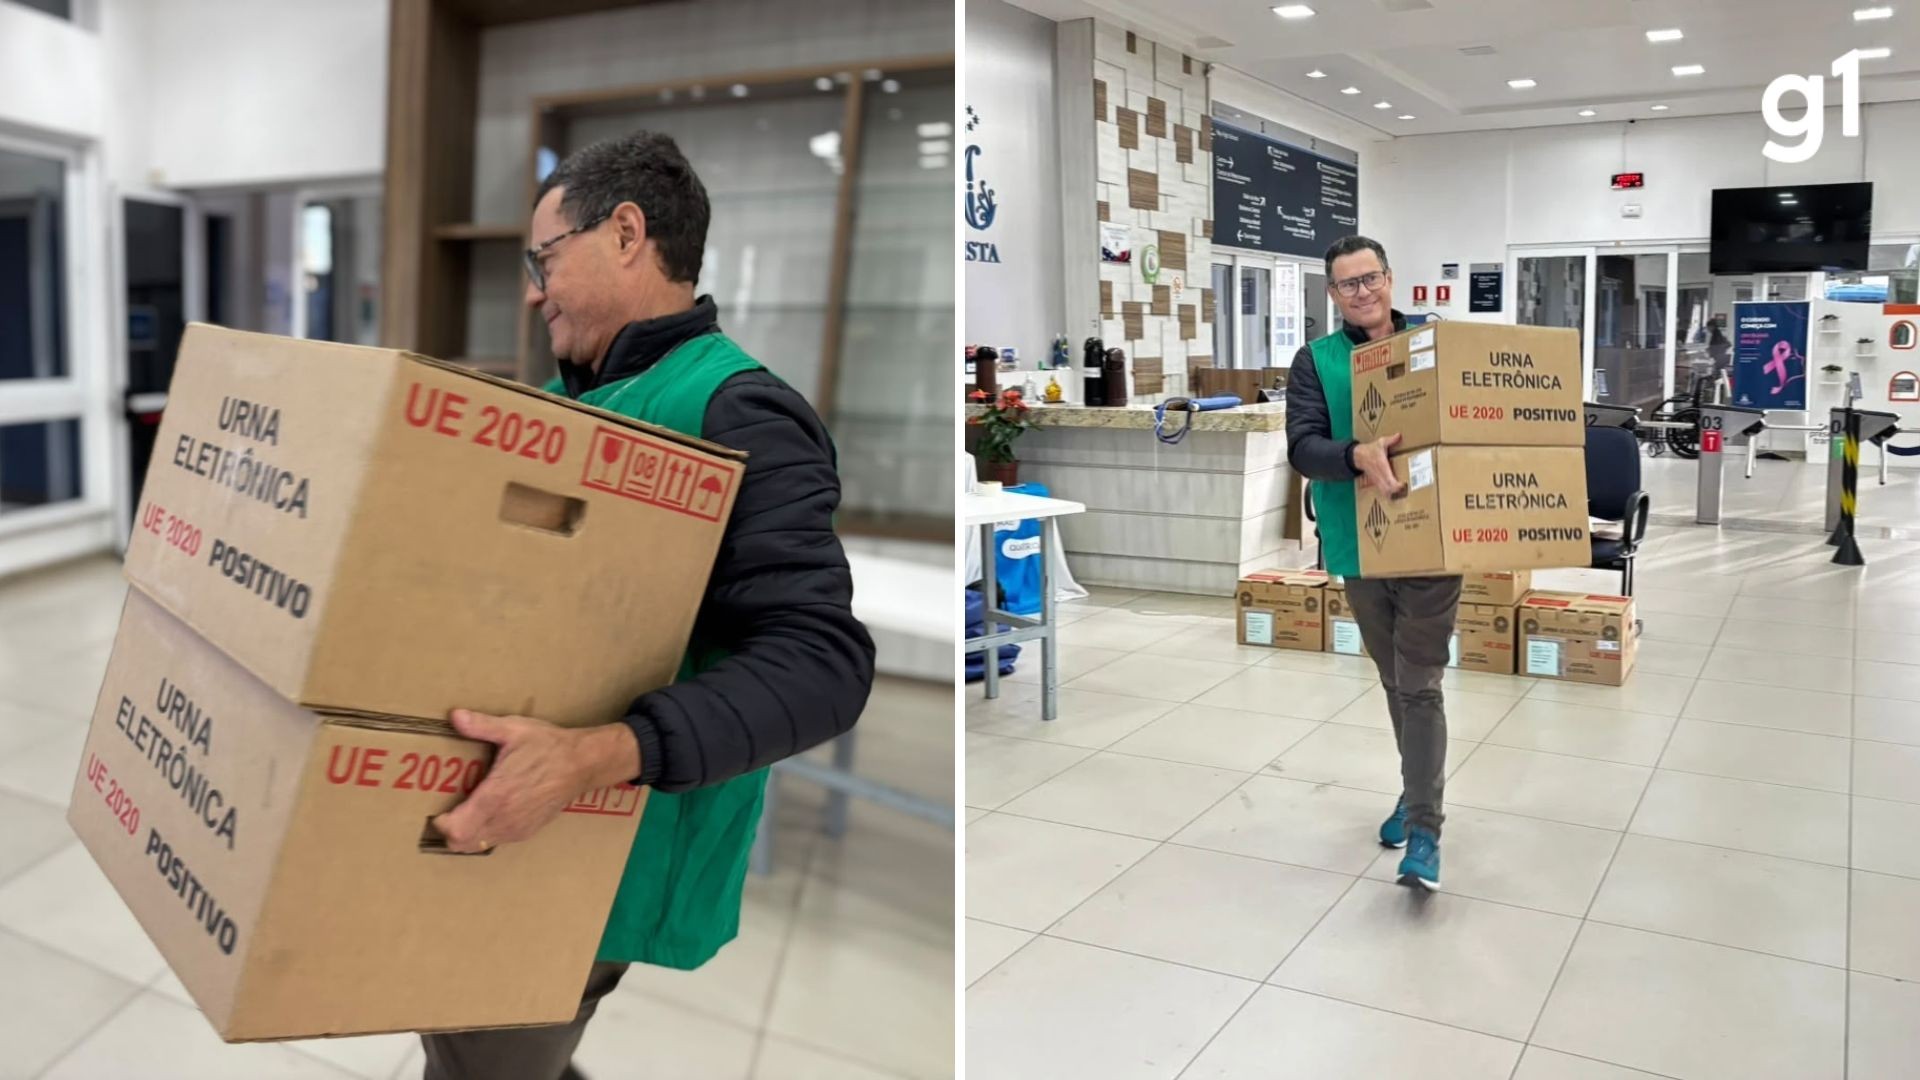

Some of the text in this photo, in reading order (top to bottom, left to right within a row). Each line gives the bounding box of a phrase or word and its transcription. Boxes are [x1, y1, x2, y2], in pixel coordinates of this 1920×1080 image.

[965, 241, 1001, 263] STA
[1490, 351, 1534, 368] URNA
[1462, 370, 1562, 390] ELETRÔNICA
[218, 396, 281, 446] URNA
[404, 382, 567, 465] UE 2020
[1449, 405, 1577, 422] UE 2020 POSITIVO
[1702, 416, 1723, 430] 03
[173, 434, 311, 519] ELETRÔNICA
[632, 452, 657, 479] 08
[1492, 472, 1538, 488] URNA
[1465, 491, 1567, 510] ELETRÔNICA
[1452, 527, 1583, 542] UE 2020 POSITIVO
[142, 501, 312, 619] UE 2020 POSITIVO
[157, 677, 212, 756] URNA
[116, 696, 238, 850] ELETRÔNICA
[326, 745, 484, 796] UE 2020
[87, 752, 239, 955] UE 2020 POSITIVO
